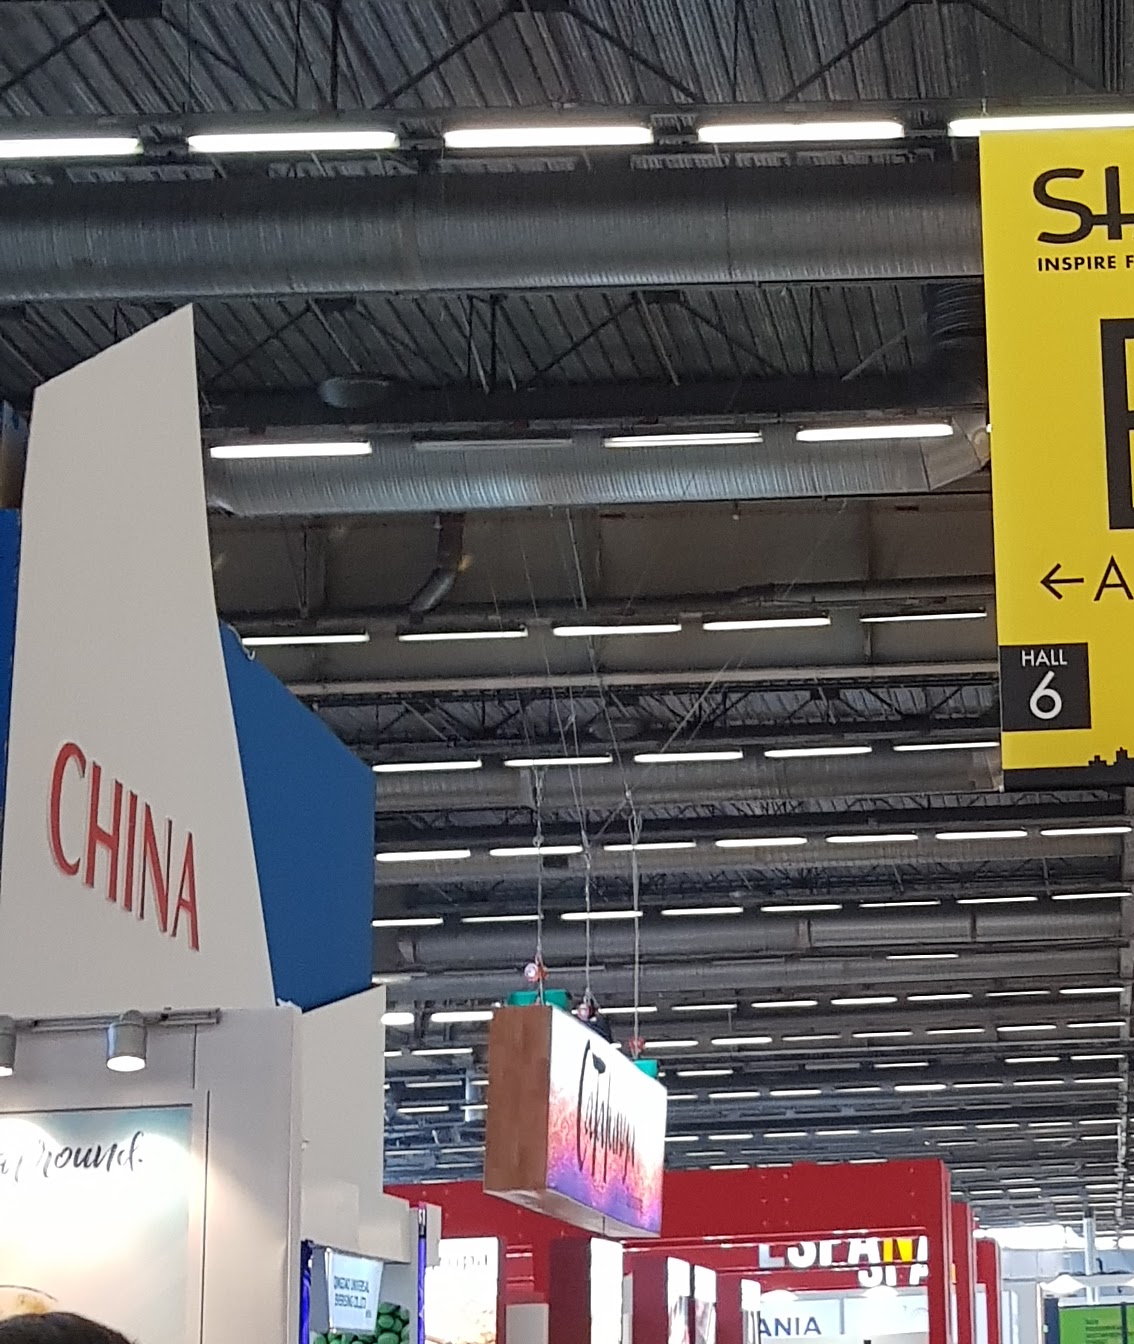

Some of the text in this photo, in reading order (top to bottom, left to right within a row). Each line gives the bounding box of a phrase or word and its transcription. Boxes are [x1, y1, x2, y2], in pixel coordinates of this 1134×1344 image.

[1038, 256, 1116, 271] INSPIRE
[1021, 649, 1068, 666] HALL
[1029, 670, 1062, 720] 6
[48, 742, 199, 952] CHINA
